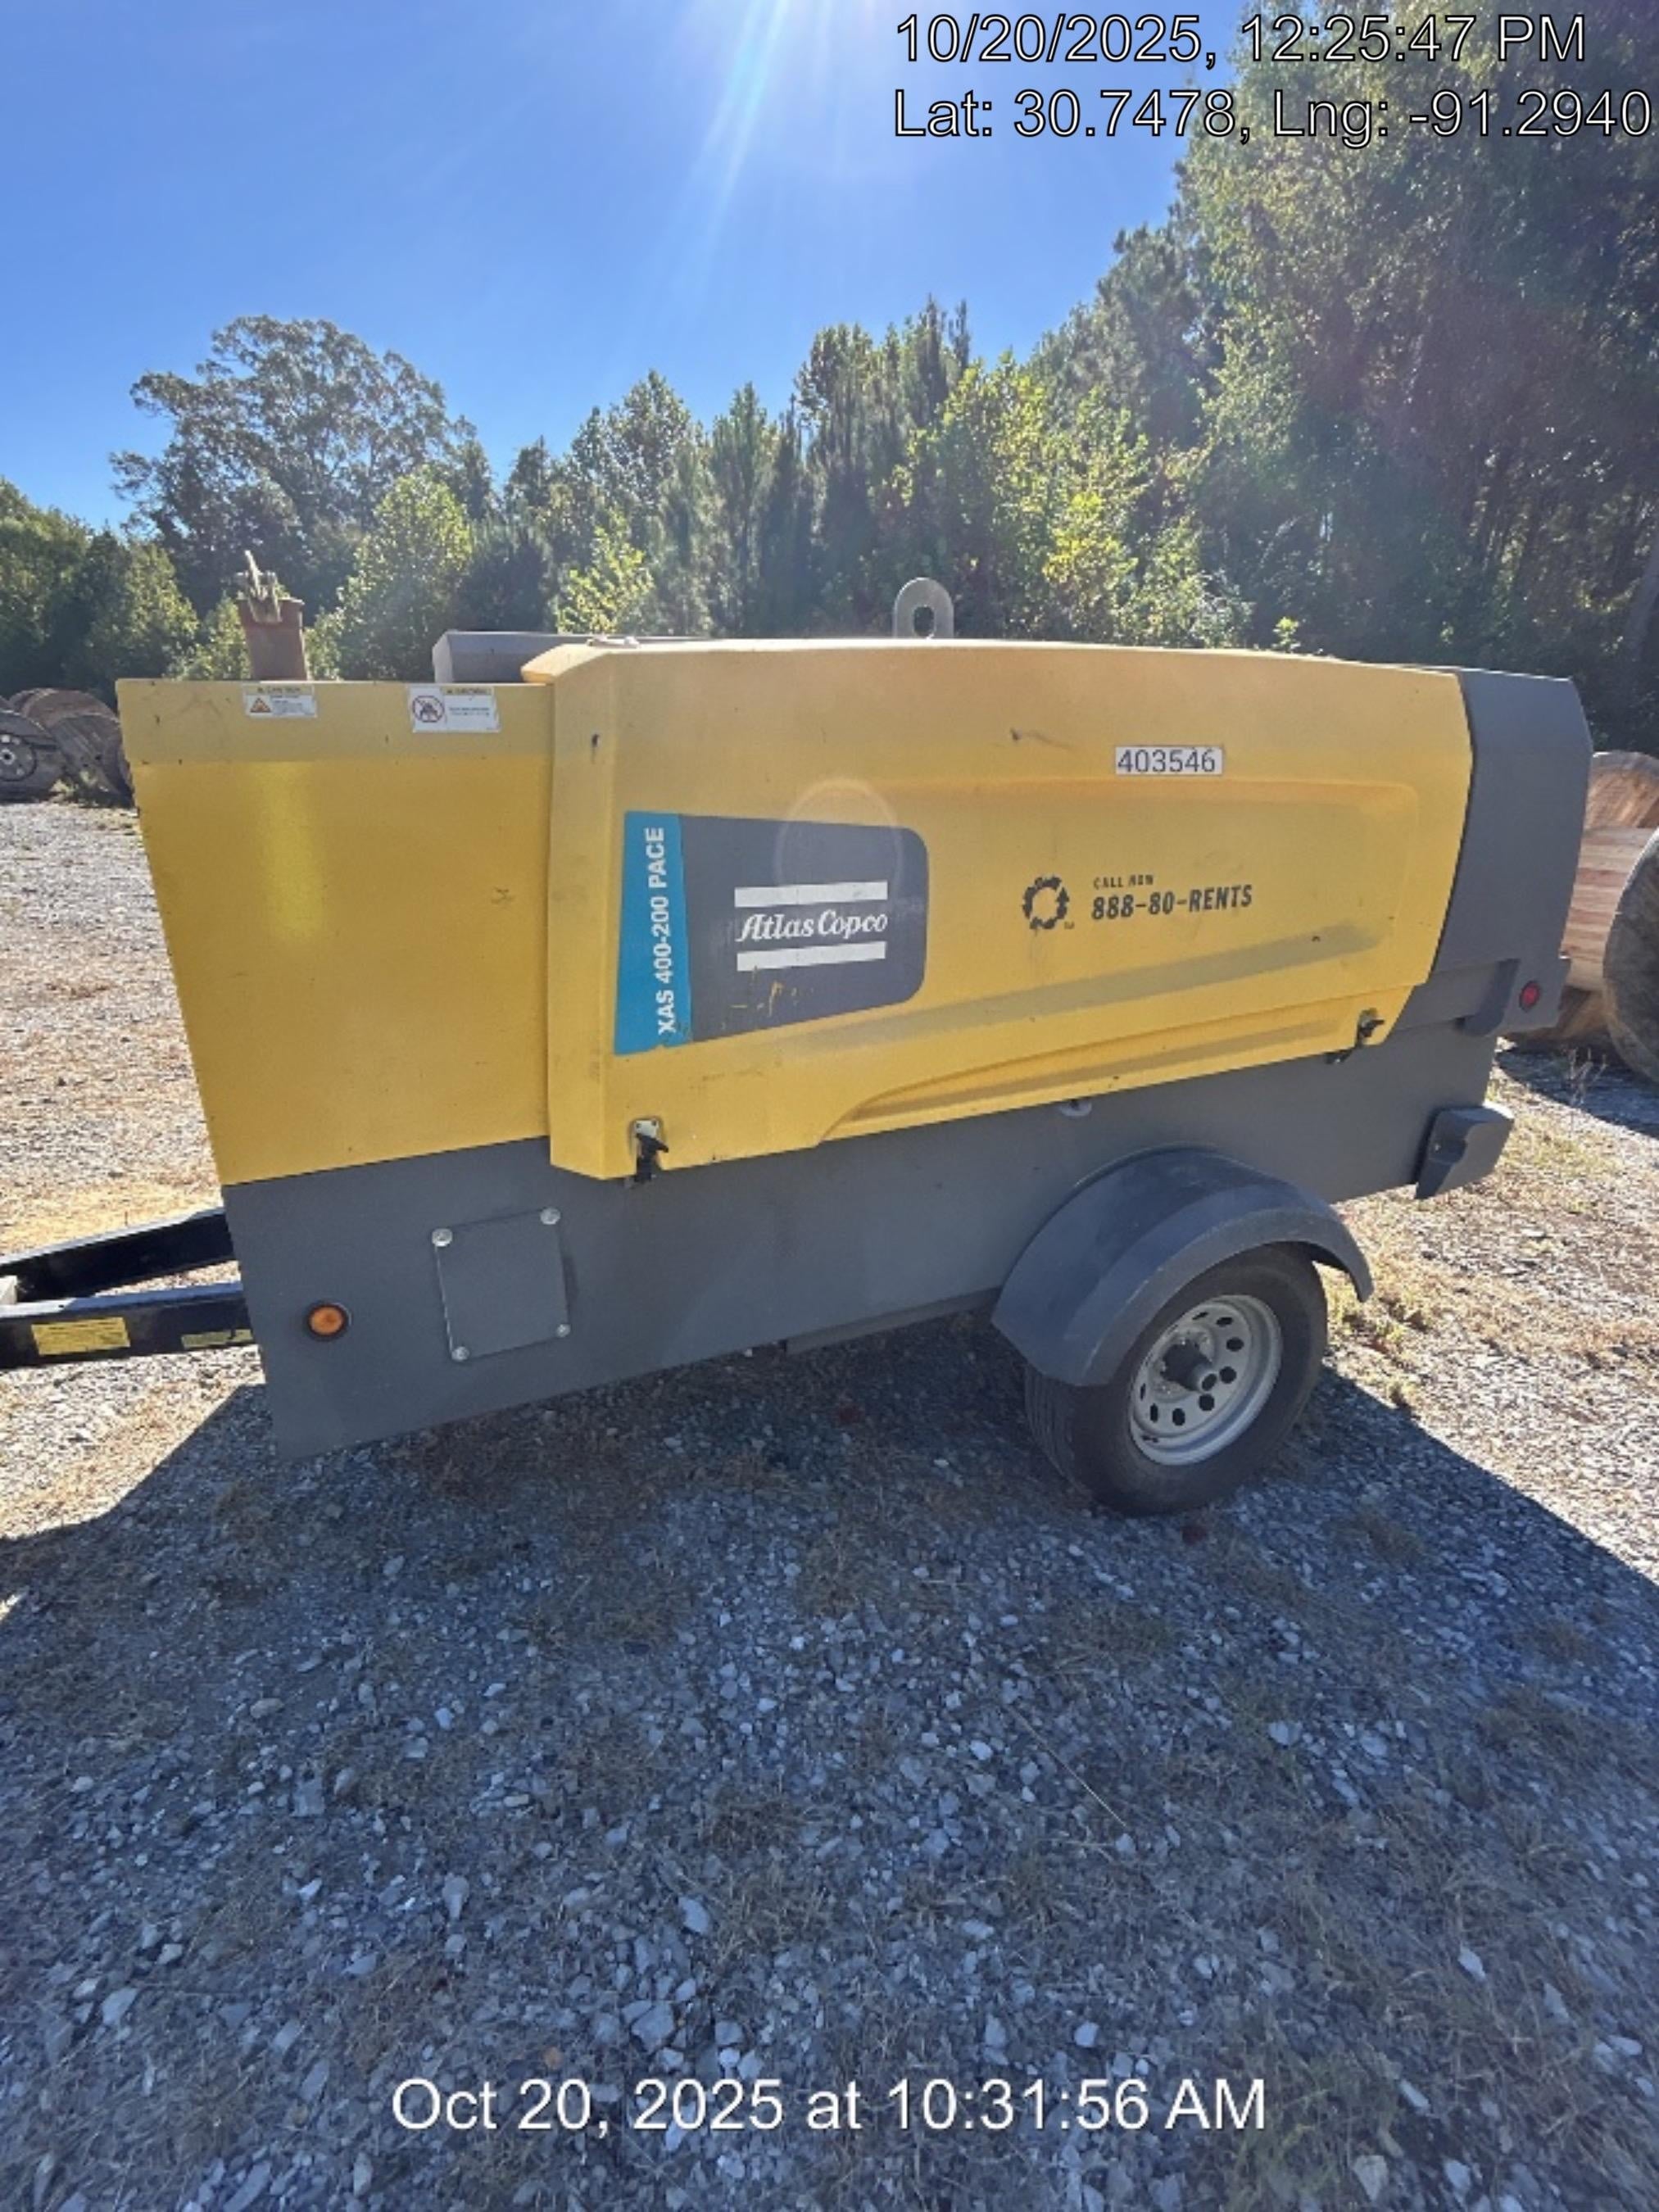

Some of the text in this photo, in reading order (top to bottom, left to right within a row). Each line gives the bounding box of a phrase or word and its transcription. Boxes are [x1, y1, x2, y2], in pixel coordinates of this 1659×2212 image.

[1117, 748, 1216, 773] 403546
[1093, 877, 1123, 889] CALL
[1091, 884, 1253, 920] 888-80-RENTS
[646, 827, 676, 1035] XAS 400-200 PACE
